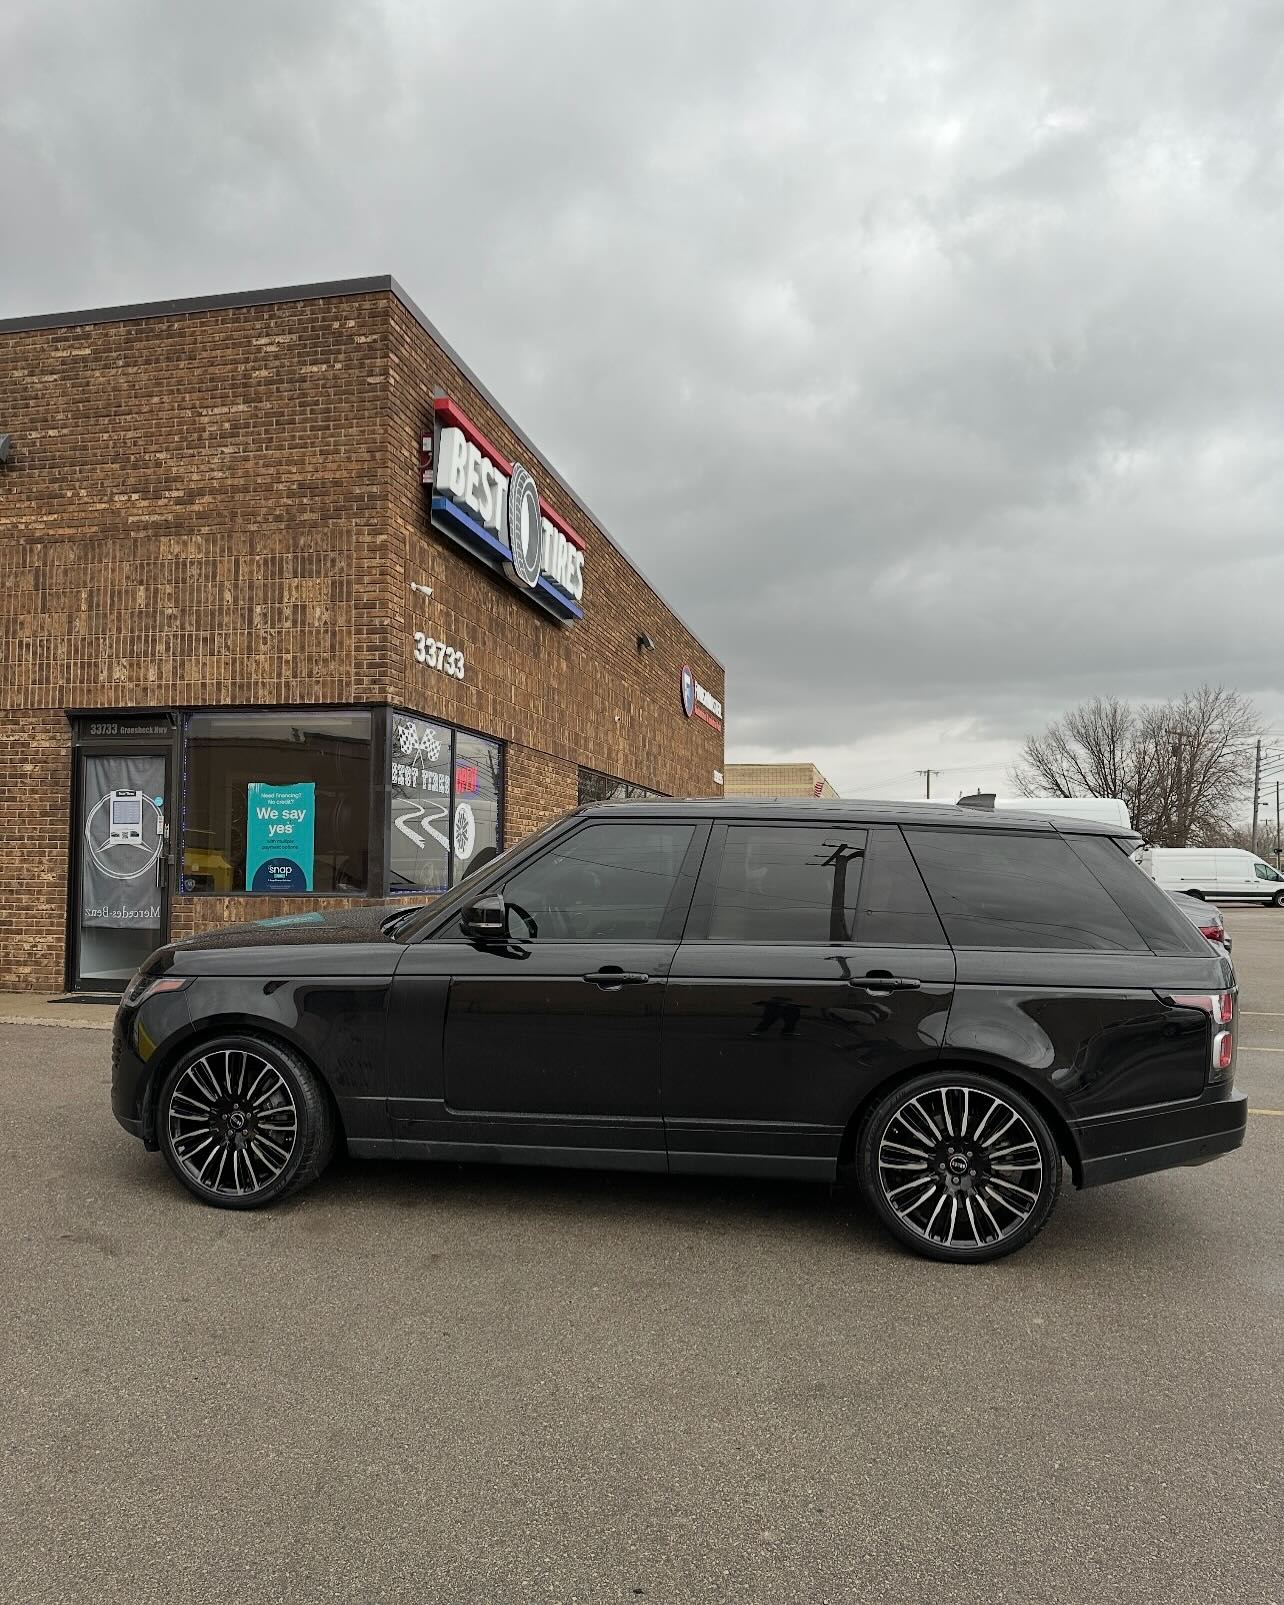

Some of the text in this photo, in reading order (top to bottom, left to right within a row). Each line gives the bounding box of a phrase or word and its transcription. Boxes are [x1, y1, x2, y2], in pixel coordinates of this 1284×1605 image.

[437, 427, 585, 601] BEST TIRES
[413, 631, 465, 680] 33733
[90, 723, 117, 734] 33733
[256, 807, 306, 821] We say
[269, 865, 292, 876] snap
